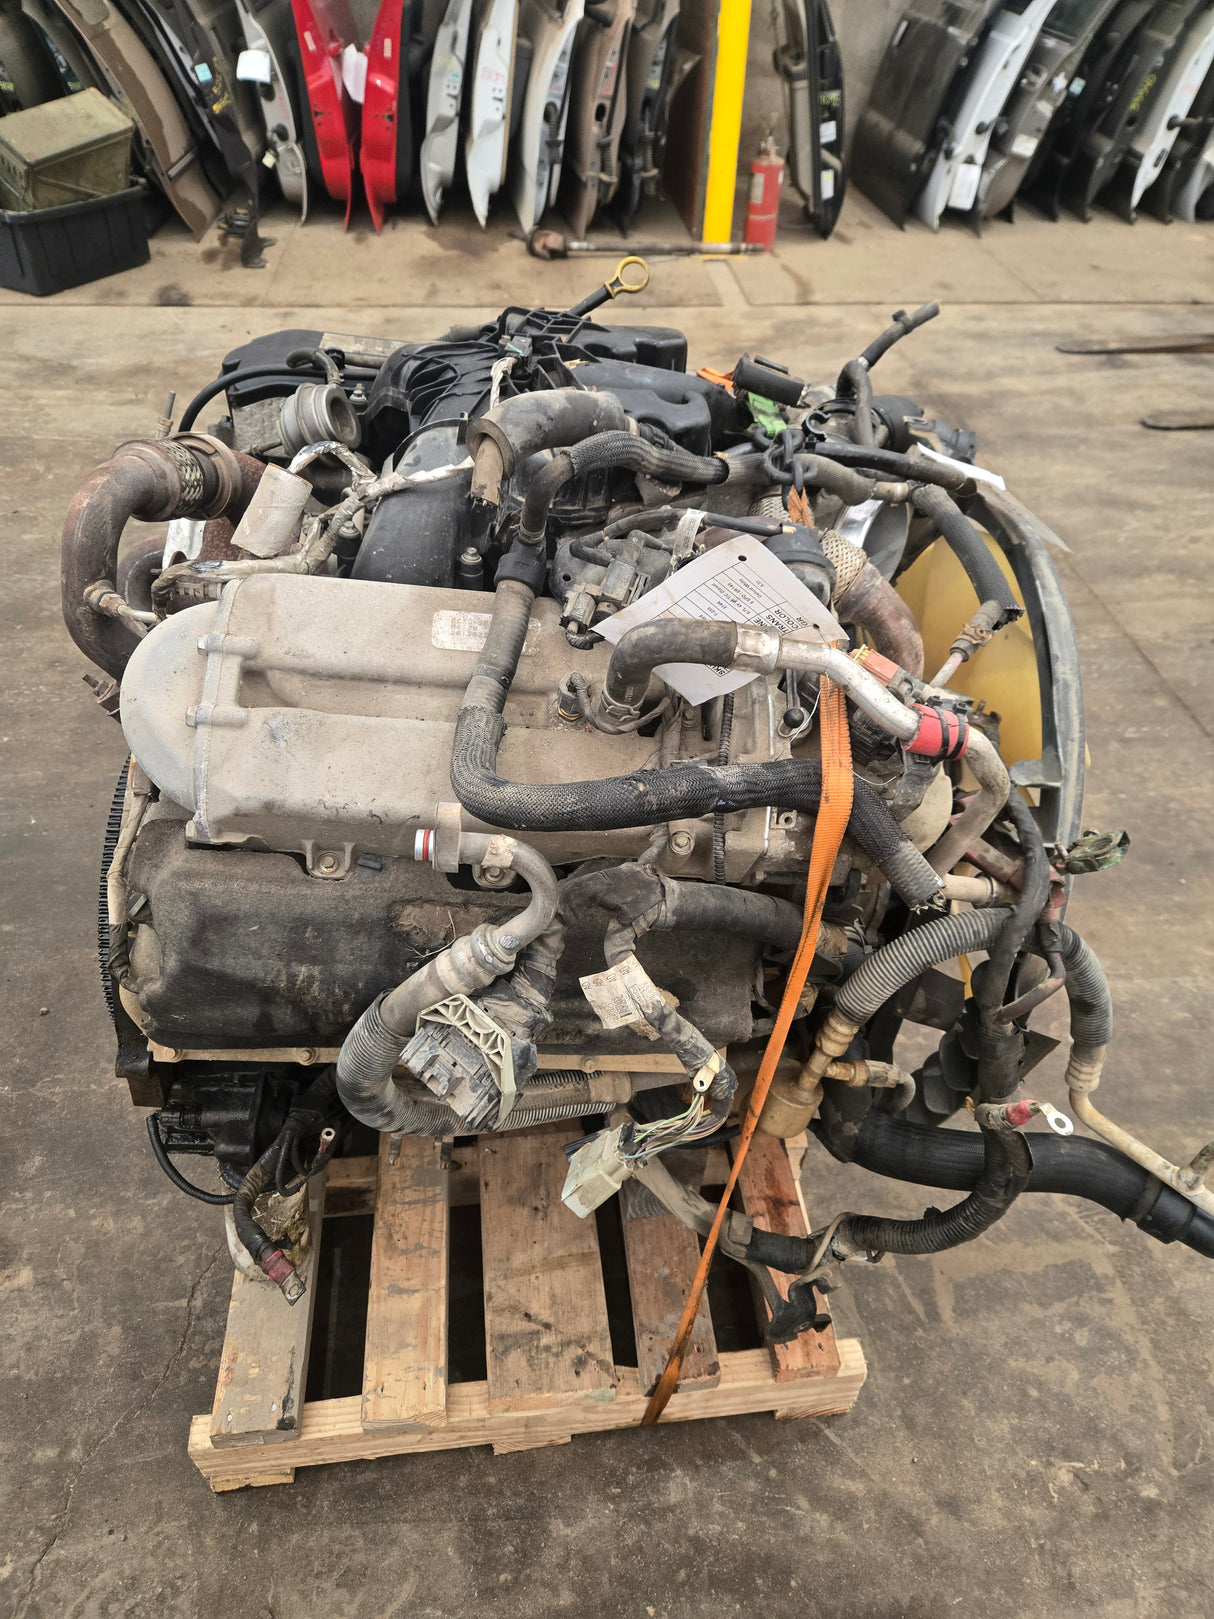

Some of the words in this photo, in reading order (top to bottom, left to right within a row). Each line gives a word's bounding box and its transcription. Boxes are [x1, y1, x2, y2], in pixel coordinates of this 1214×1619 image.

[765, 614, 789, 633] TRANS
[773, 608, 799, 629] COLOR
[795, 615, 808, 626] GR
